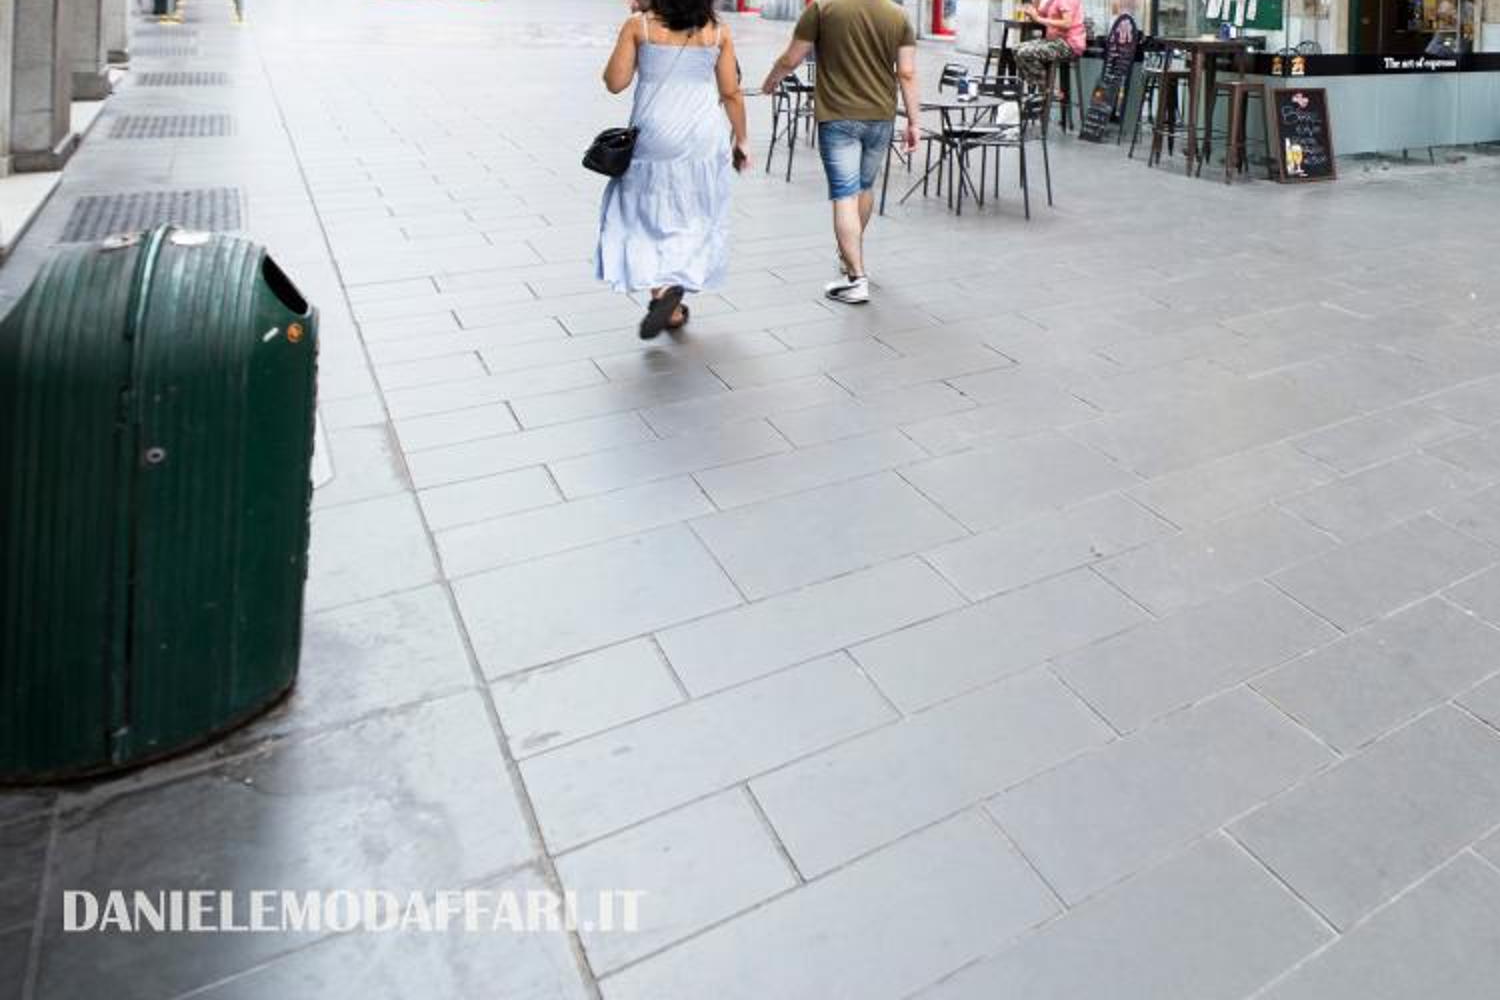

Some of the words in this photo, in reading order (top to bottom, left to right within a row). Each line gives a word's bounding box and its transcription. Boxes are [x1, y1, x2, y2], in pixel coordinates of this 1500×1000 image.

[1383, 57, 1400, 69] The
[1401, 58, 1415, 69] art
[1415, 57, 1425, 69] of
